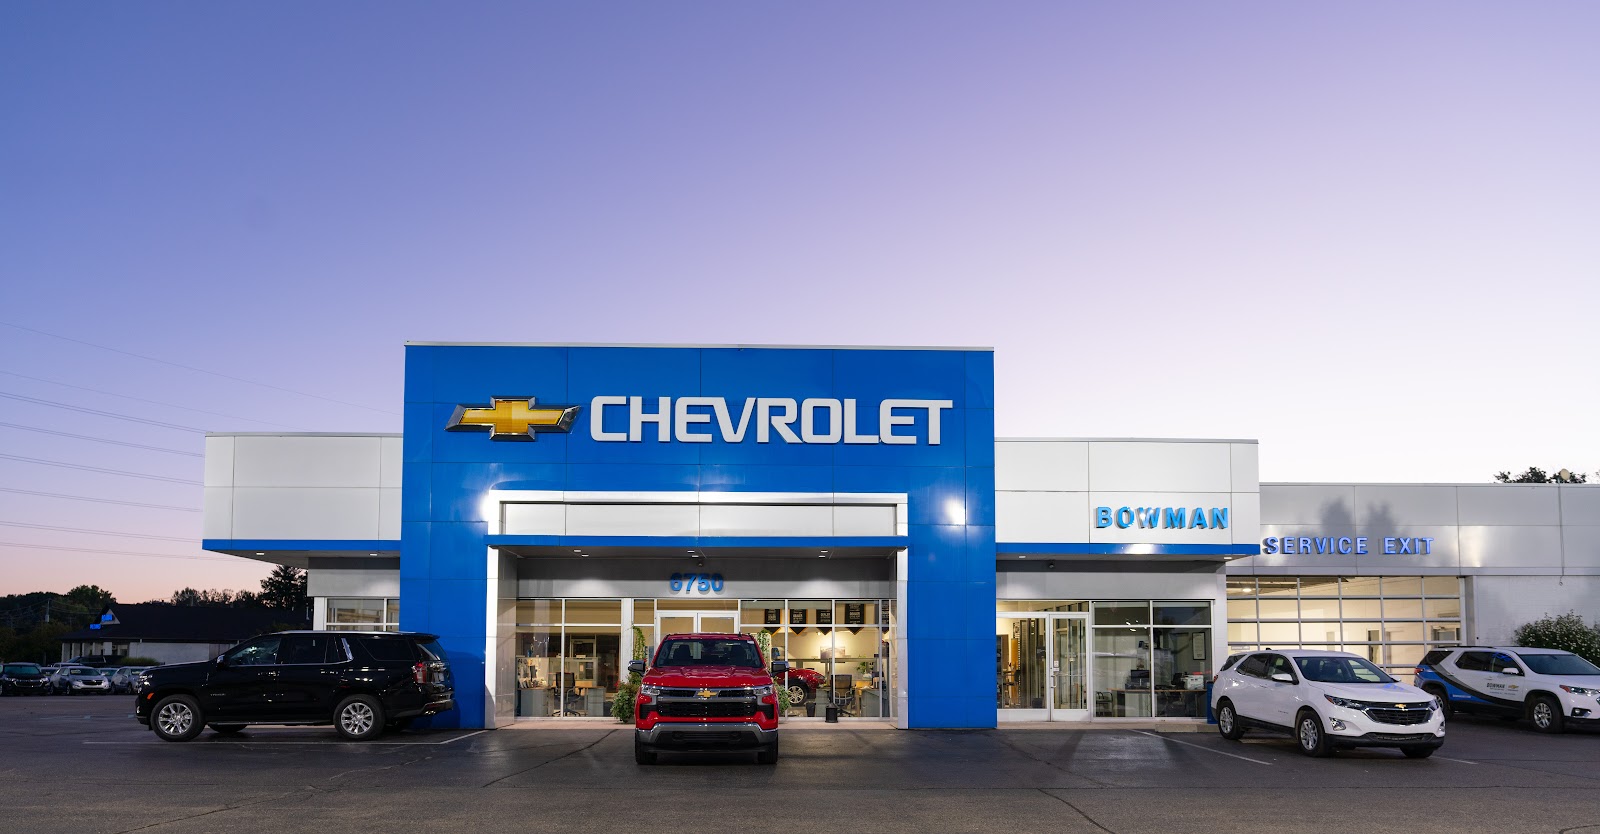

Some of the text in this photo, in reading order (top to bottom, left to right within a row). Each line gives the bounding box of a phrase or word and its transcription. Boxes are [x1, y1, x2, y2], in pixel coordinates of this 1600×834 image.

[590, 396, 954, 445] CHEVROLET
[1095, 505, 1230, 530] BOWMAN
[1263, 536, 1435, 556] SERVICE EXIT
[669, 572, 725, 592] 6750
